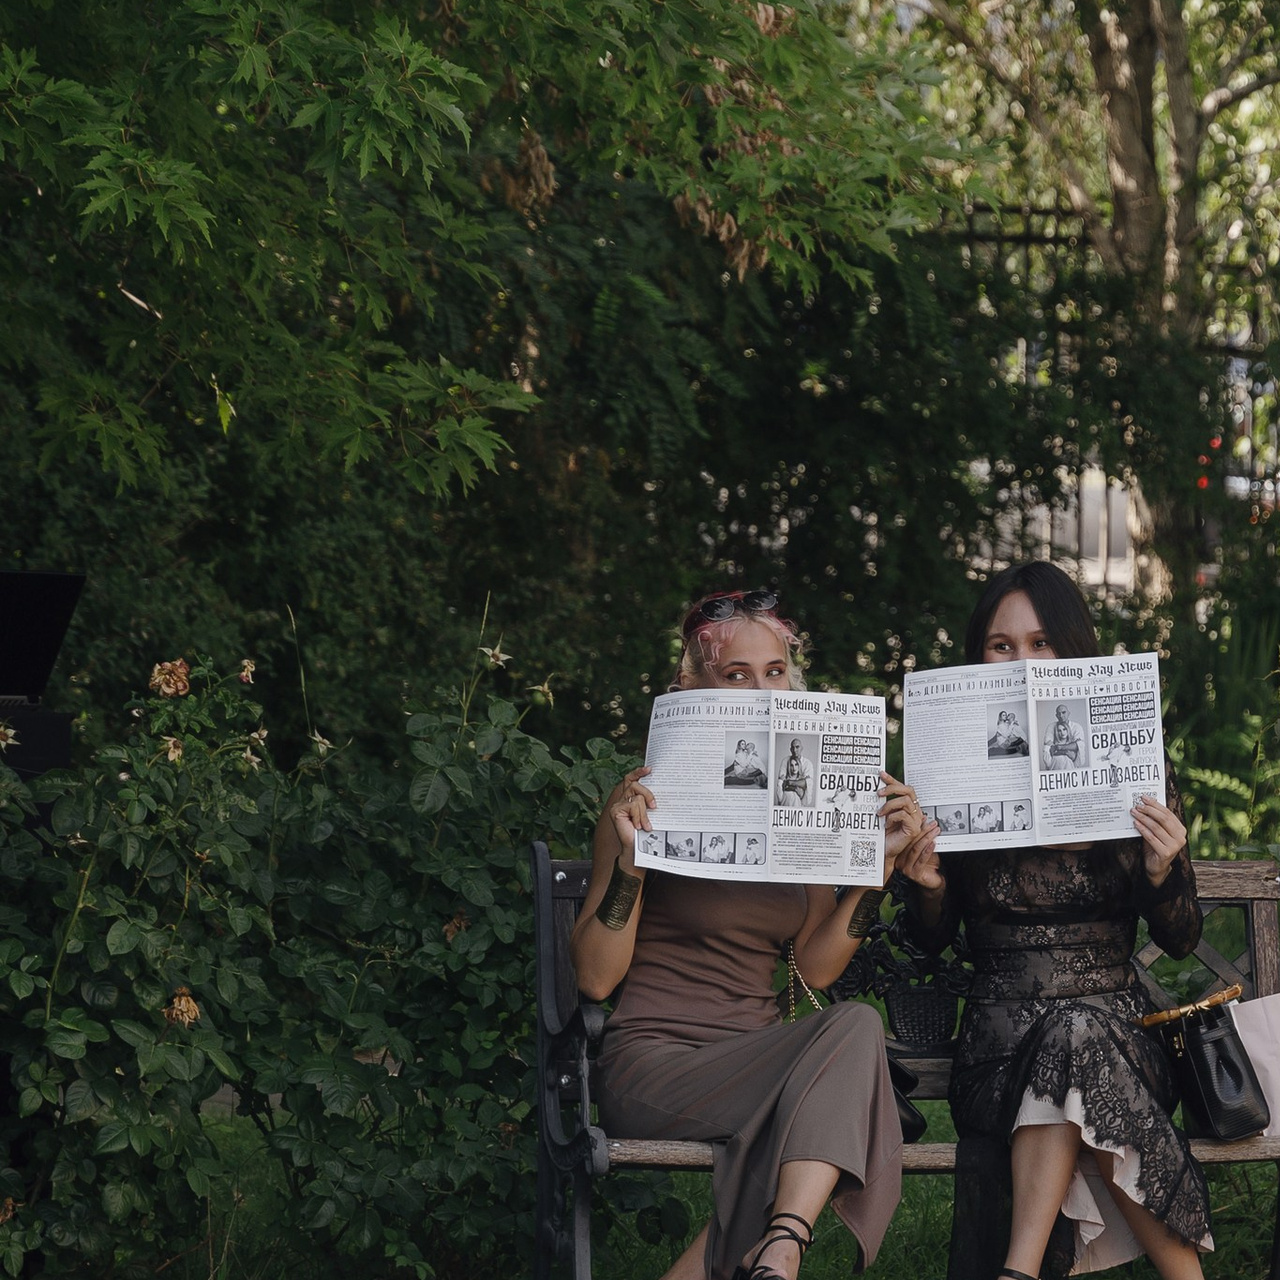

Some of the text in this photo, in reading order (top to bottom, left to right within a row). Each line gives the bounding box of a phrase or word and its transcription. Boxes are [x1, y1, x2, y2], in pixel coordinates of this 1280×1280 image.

[1032, 662, 1152, 679] Wedding Day News
[1032, 685, 1098, 698] СВАДЕБНЫЕ
[1106, 680, 1156, 693] НОВОСТИ
[774, 698, 880, 715] Wedding Day News
[1090, 692, 1154, 706] СЕНСАЦИЯ СЕНСАЦИЯ
[1091, 701, 1154, 715] СЕНСАЦИЯ СЕНСАЦИЯ
[1091, 710, 1154, 724] СЕНСАЦИЯ СЕНСАЦИЯ
[772, 720, 832, 732] СВАДЕБНЫЕ
[840, 724, 882, 734] НОВОСТИ
[1091, 728, 1155, 750] СВАДЬБУ
[820, 774, 880, 792] СВАДЬБУ
[1039, 772, 1078, 792] ДЕНИС
[1081, 770, 1089, 786] И
[772, 809, 803, 828] ДЕНИС
[806, 810, 813, 827] И
